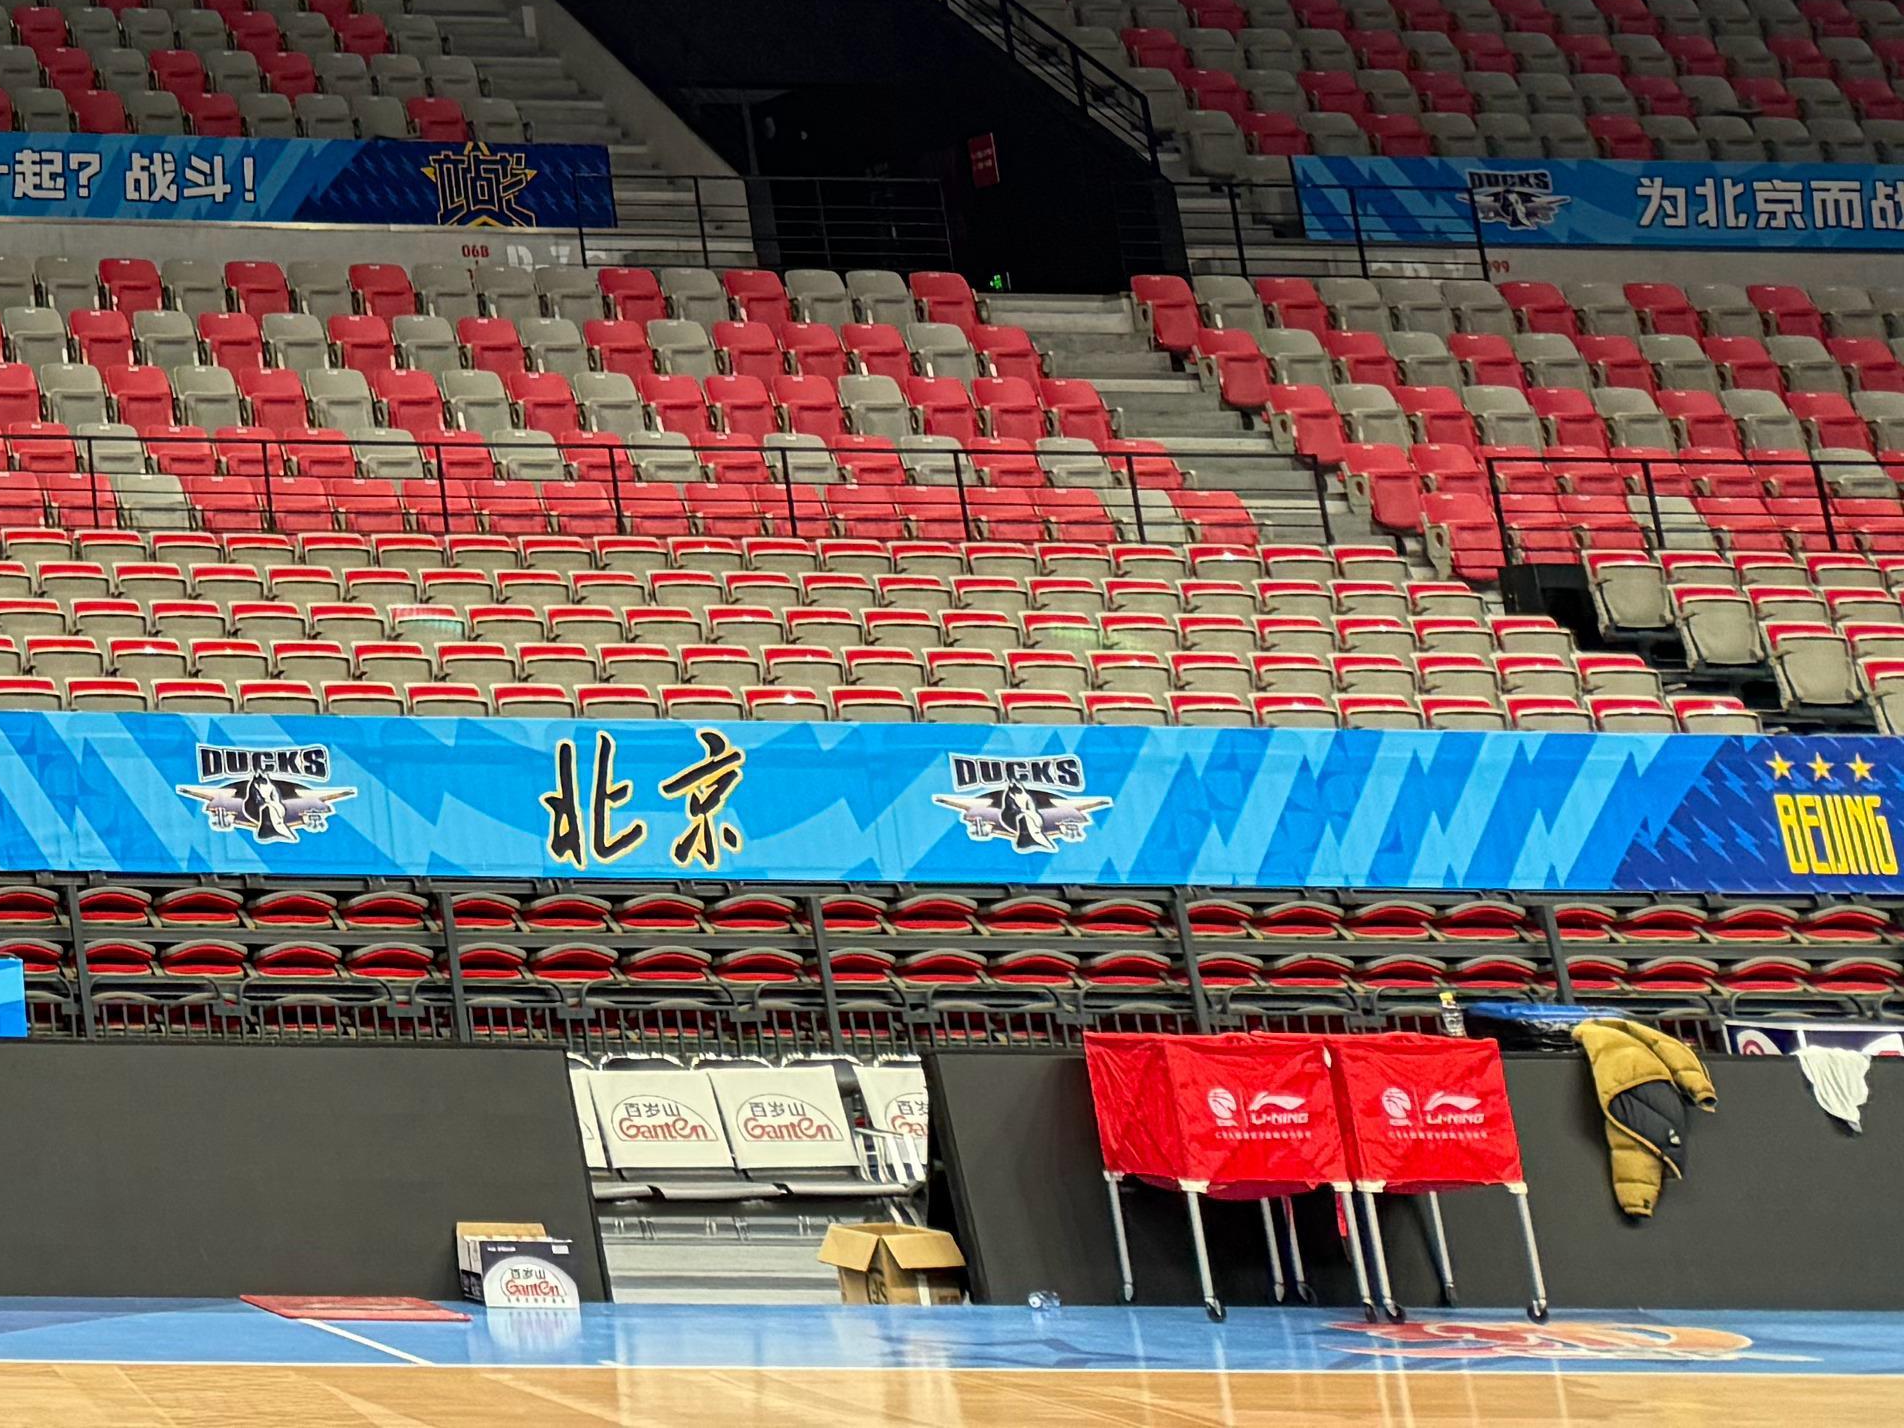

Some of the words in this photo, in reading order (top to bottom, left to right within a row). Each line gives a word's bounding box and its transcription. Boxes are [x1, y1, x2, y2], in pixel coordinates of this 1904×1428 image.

[1469, 171, 1549, 189] DUCKS
[201, 749, 326, 777] DUCKS
[955, 759, 1080, 787] DUCKS
[545, 729, 745, 870] 北京
[1774, 794, 1898, 875] BEIJING
[624, 1101, 681, 1117] 百岁山
[749, 1101, 806, 1117] 百岁山
